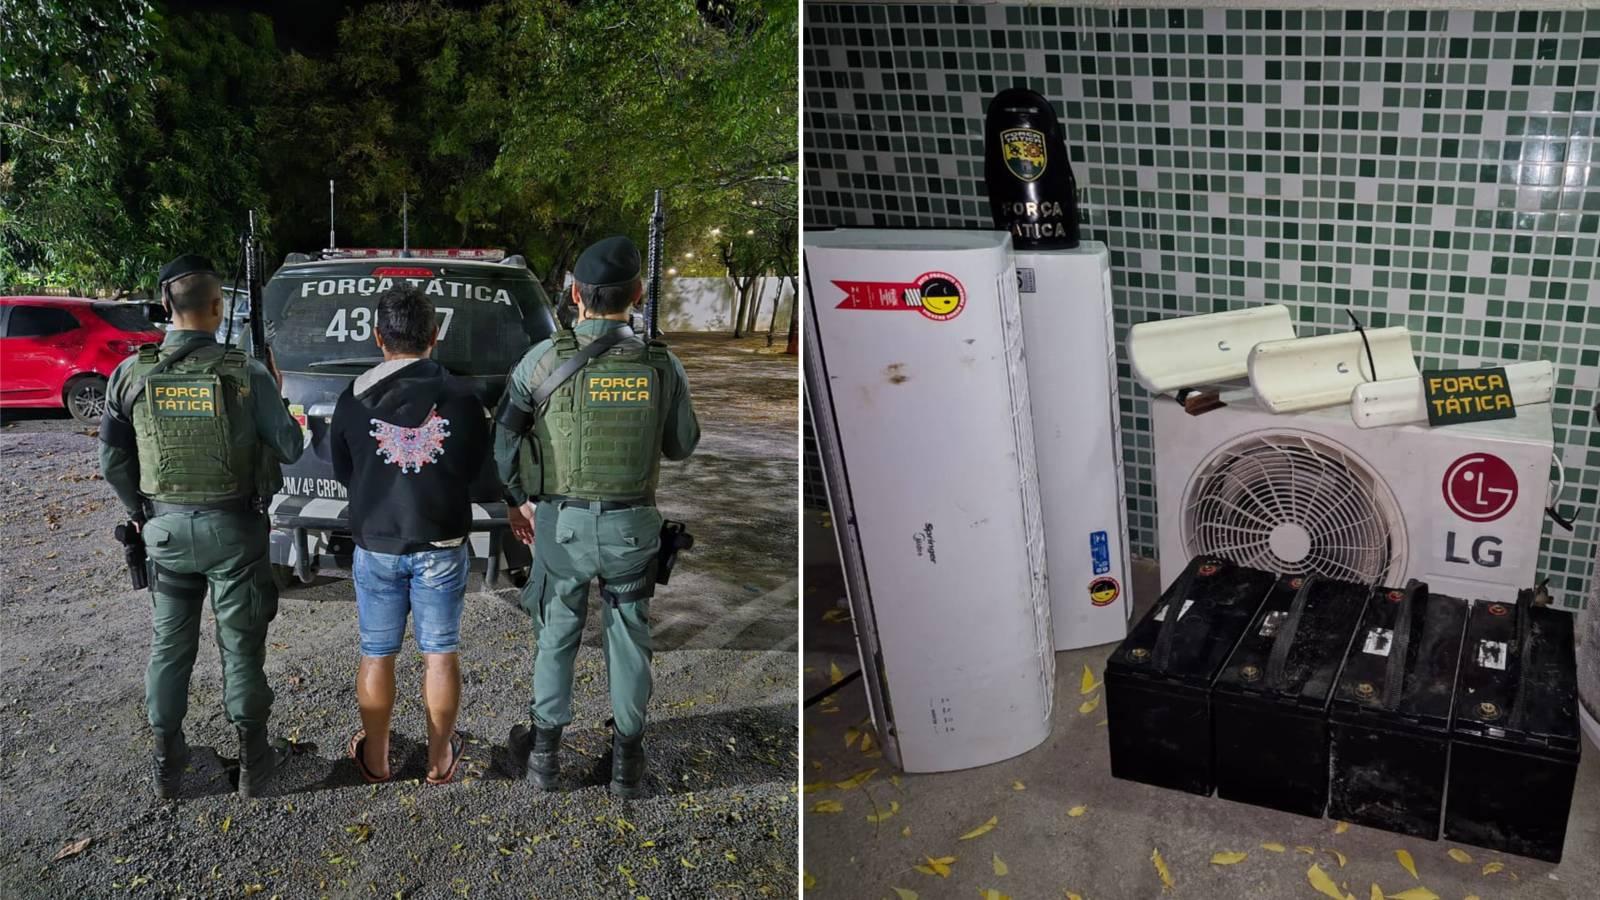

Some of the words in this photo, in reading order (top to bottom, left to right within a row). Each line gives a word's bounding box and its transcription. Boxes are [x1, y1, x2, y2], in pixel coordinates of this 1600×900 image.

[301, 277, 394, 297] FORÇA
[589, 377, 648, 389] FORÇA
[1430, 374, 1504, 395] FORÇA
[155, 398, 213, 411] TÁTICA
[589, 388, 650, 402] TÁTICA
[1432, 394, 1512, 417] TÁTICA
[316, 478, 348, 498] CRPM
[923, 522, 937, 564] Springer
[1445, 531, 1503, 568] LG
